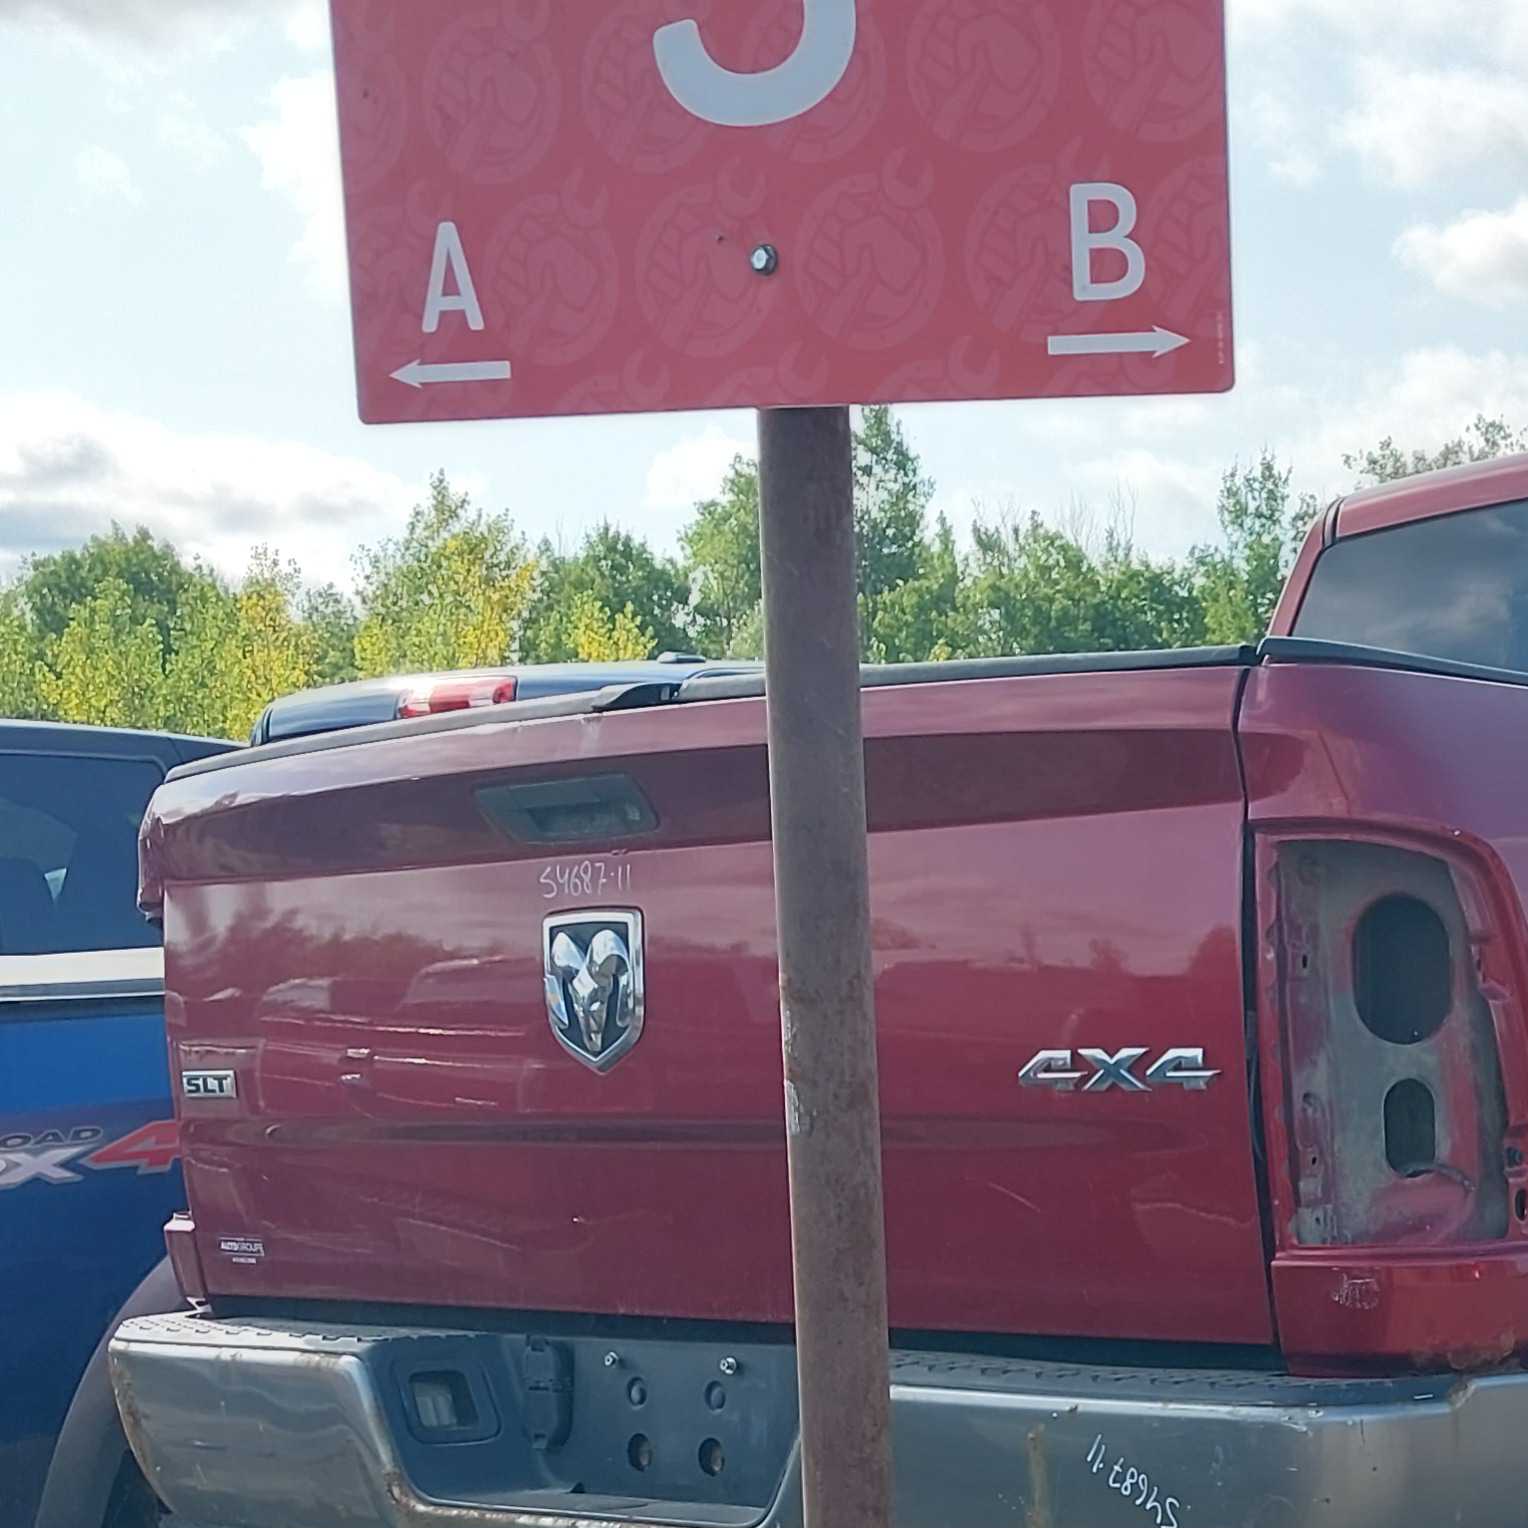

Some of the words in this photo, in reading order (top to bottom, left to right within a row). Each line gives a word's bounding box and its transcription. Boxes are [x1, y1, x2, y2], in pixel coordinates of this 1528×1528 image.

[423, 221, 484, 333] A
[1069, 182, 1147, 302] B
[187, 1077, 228, 1094] SLT
[1018, 1048, 1222, 1091] 4X4
